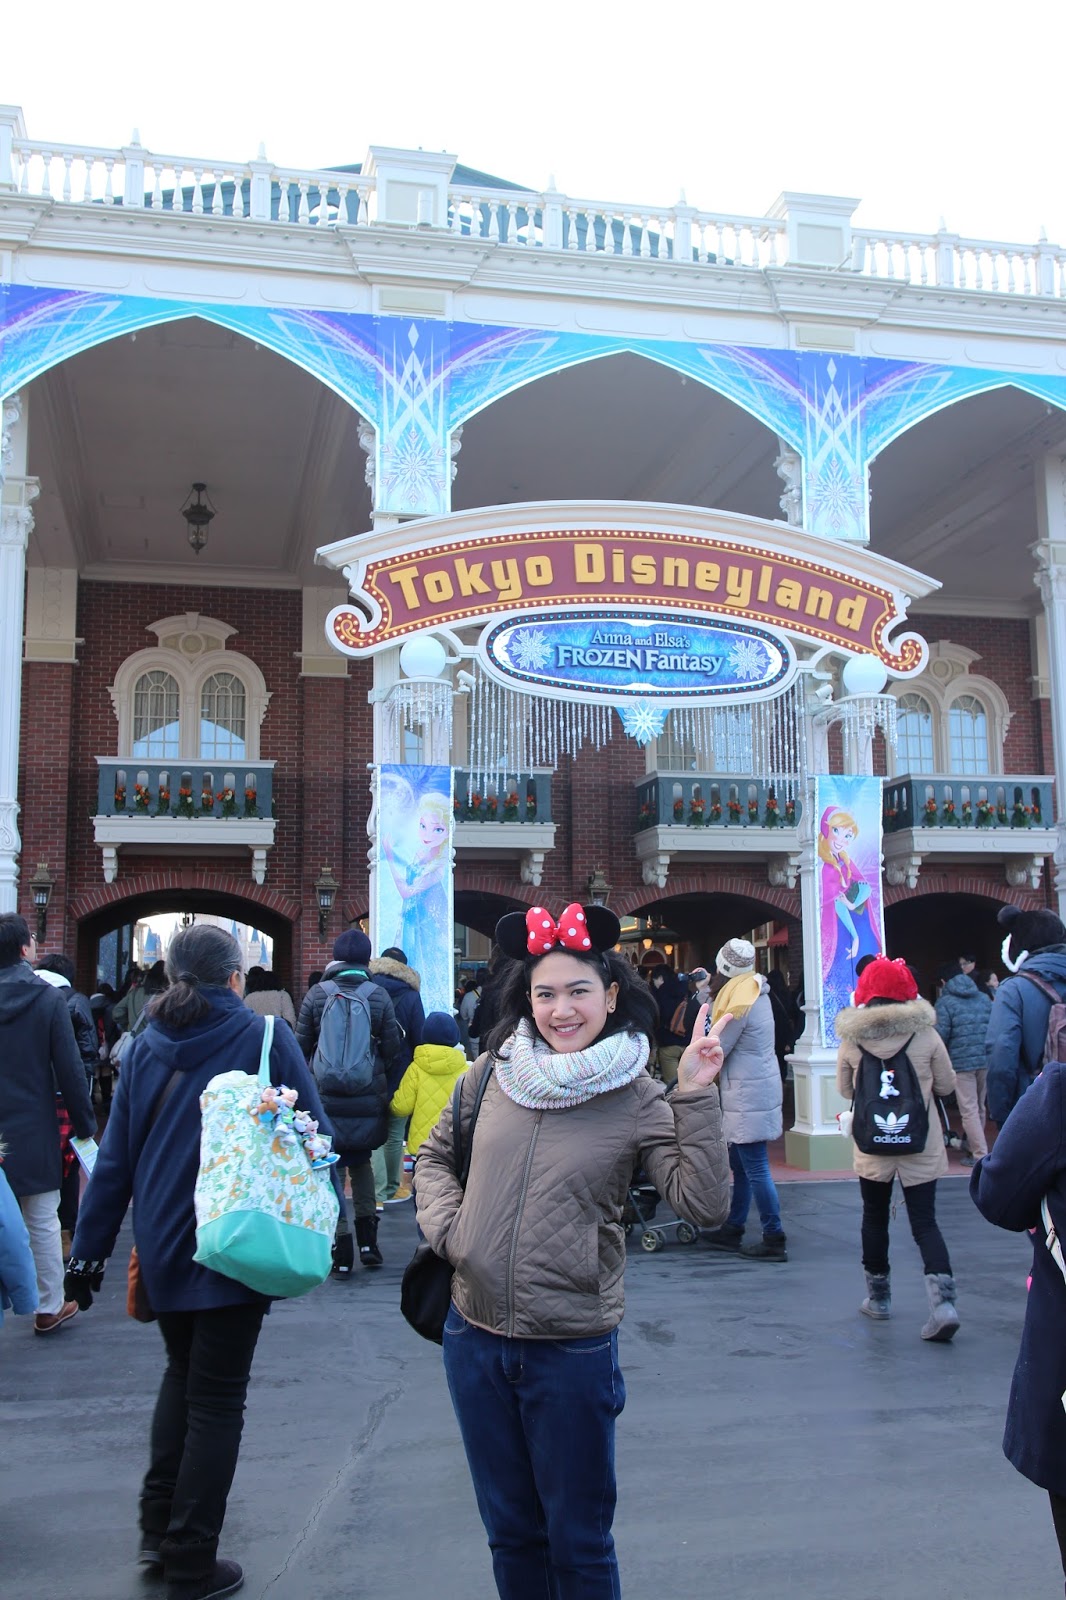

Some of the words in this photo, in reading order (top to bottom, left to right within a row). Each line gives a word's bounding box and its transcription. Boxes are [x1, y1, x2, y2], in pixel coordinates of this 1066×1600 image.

[388, 555, 553, 610] Tokyo
[573, 543, 868, 631] Disneyland
[591, 630, 632, 646] Anna
[634, 636, 652, 646] and
[654, 632, 691, 648] Elsa's
[556, 645, 642, 671] FROZEN
[645, 649, 724, 676] Fantasy
[873, 1135, 911, 1144] adidas
